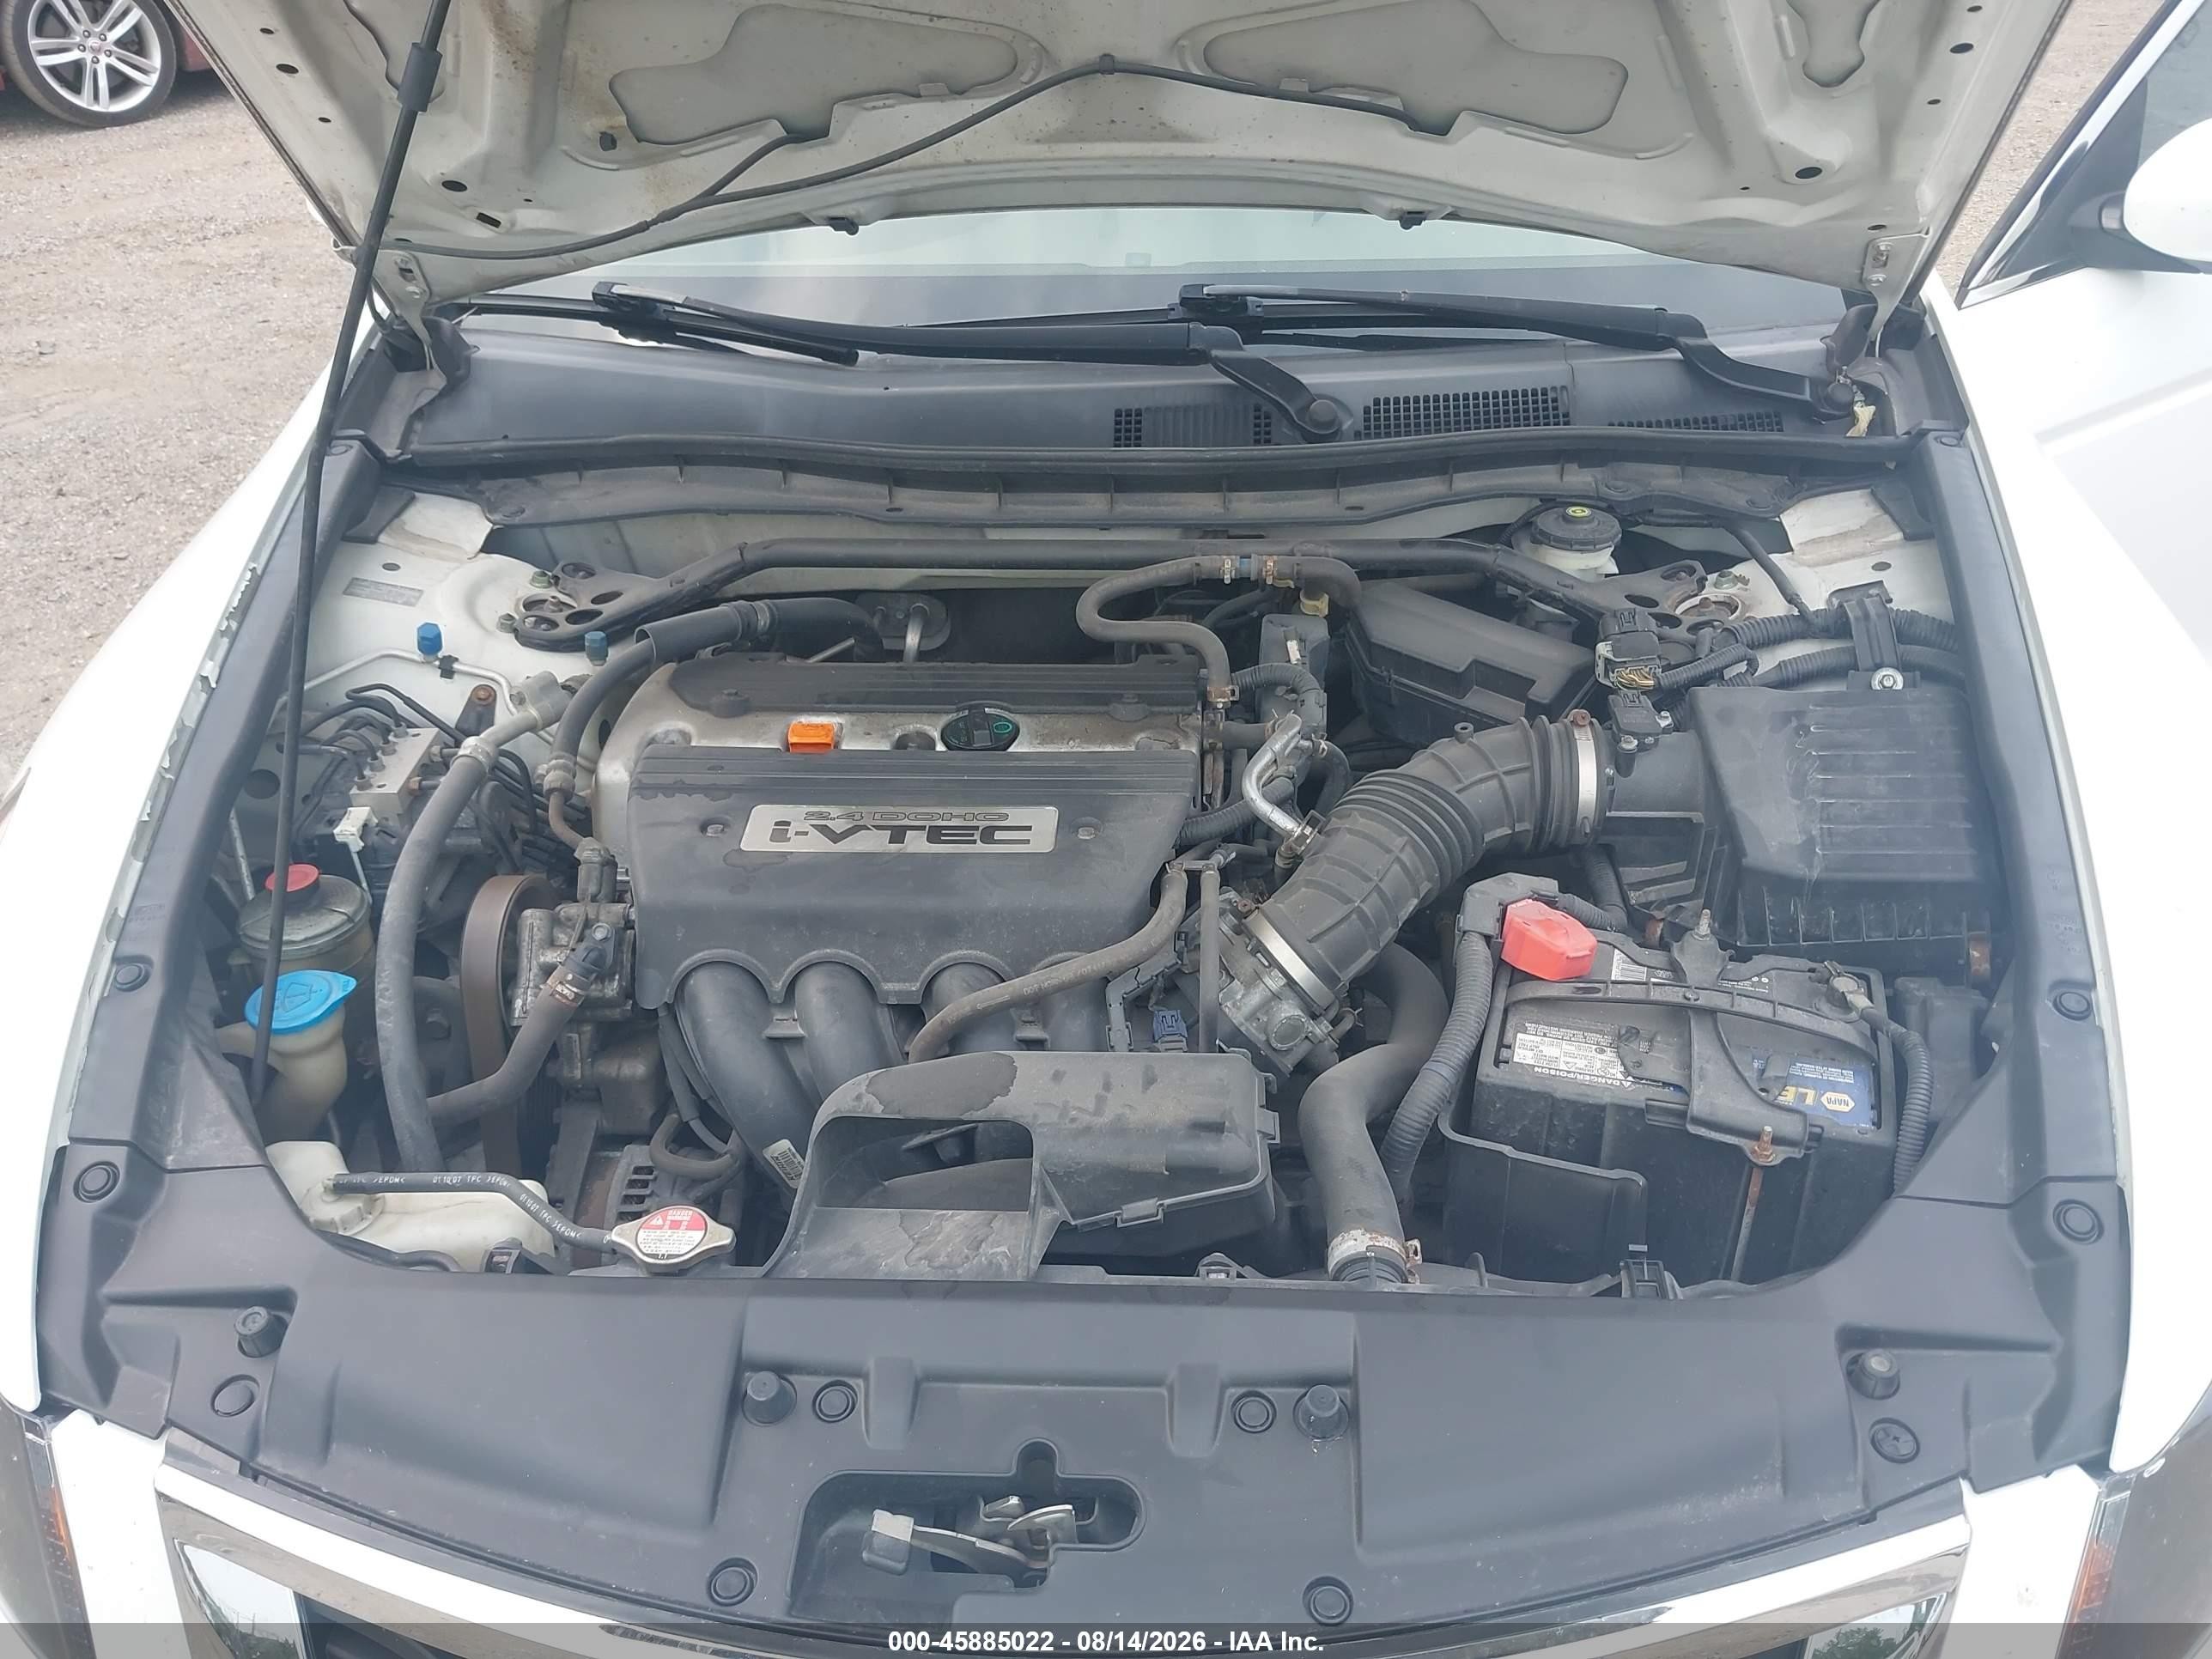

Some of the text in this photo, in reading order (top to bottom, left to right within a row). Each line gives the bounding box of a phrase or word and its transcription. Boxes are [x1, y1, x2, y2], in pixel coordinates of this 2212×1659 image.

[803, 811, 1010, 822] 2.4 DOHC
[769, 820, 1033, 845] i-VTEC
[1534, 1066, 1620, 1086] DANGER/POISON
[1826, 1096, 1850, 1107] NAPA
